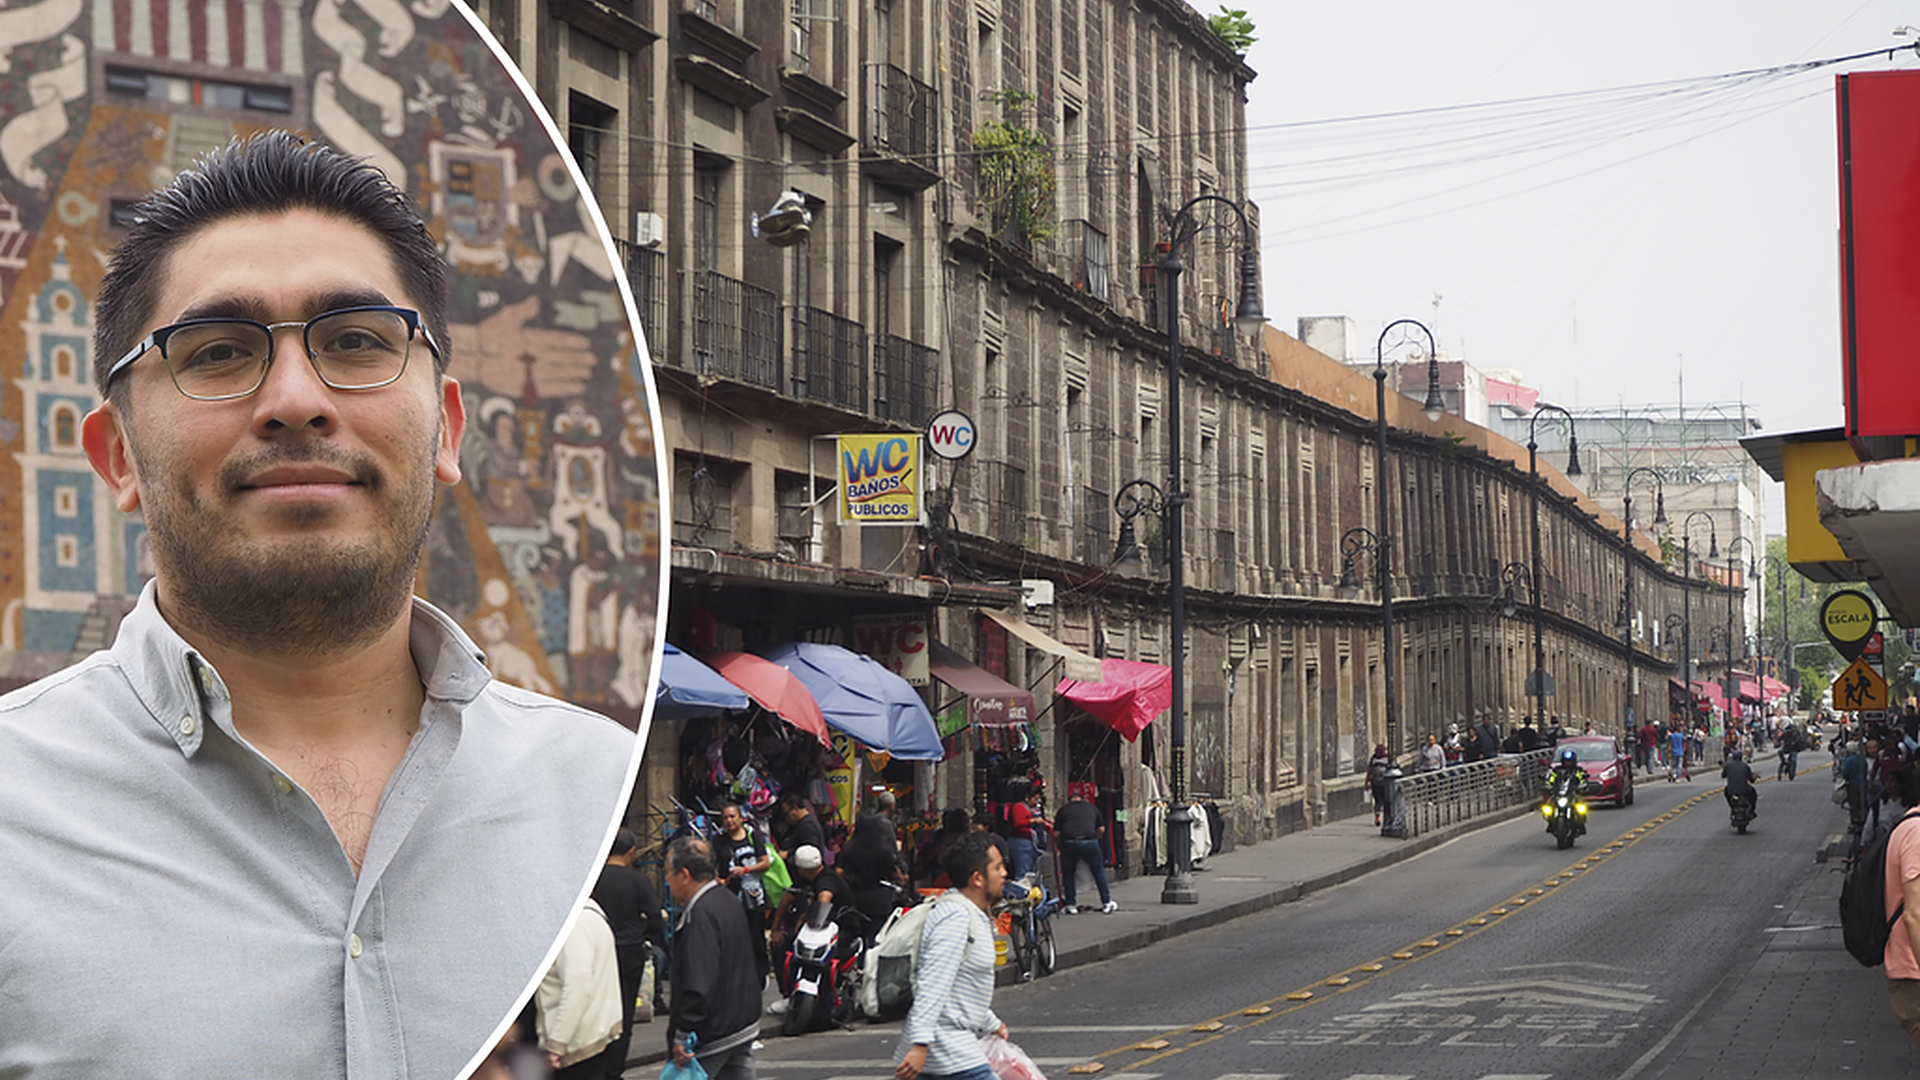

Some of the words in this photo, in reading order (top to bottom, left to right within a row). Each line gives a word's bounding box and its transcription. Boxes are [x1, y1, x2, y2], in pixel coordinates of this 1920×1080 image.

[932, 425, 971, 446] WC
[843, 438, 909, 484] WC
[848, 475, 900, 498] BAÑOS
[848, 503, 909, 516] PUBLICOS
[1828, 613, 1870, 625] ESCALA
[856, 624, 925, 655] WC
[1247, 1029, 1626, 1047] SOLO
